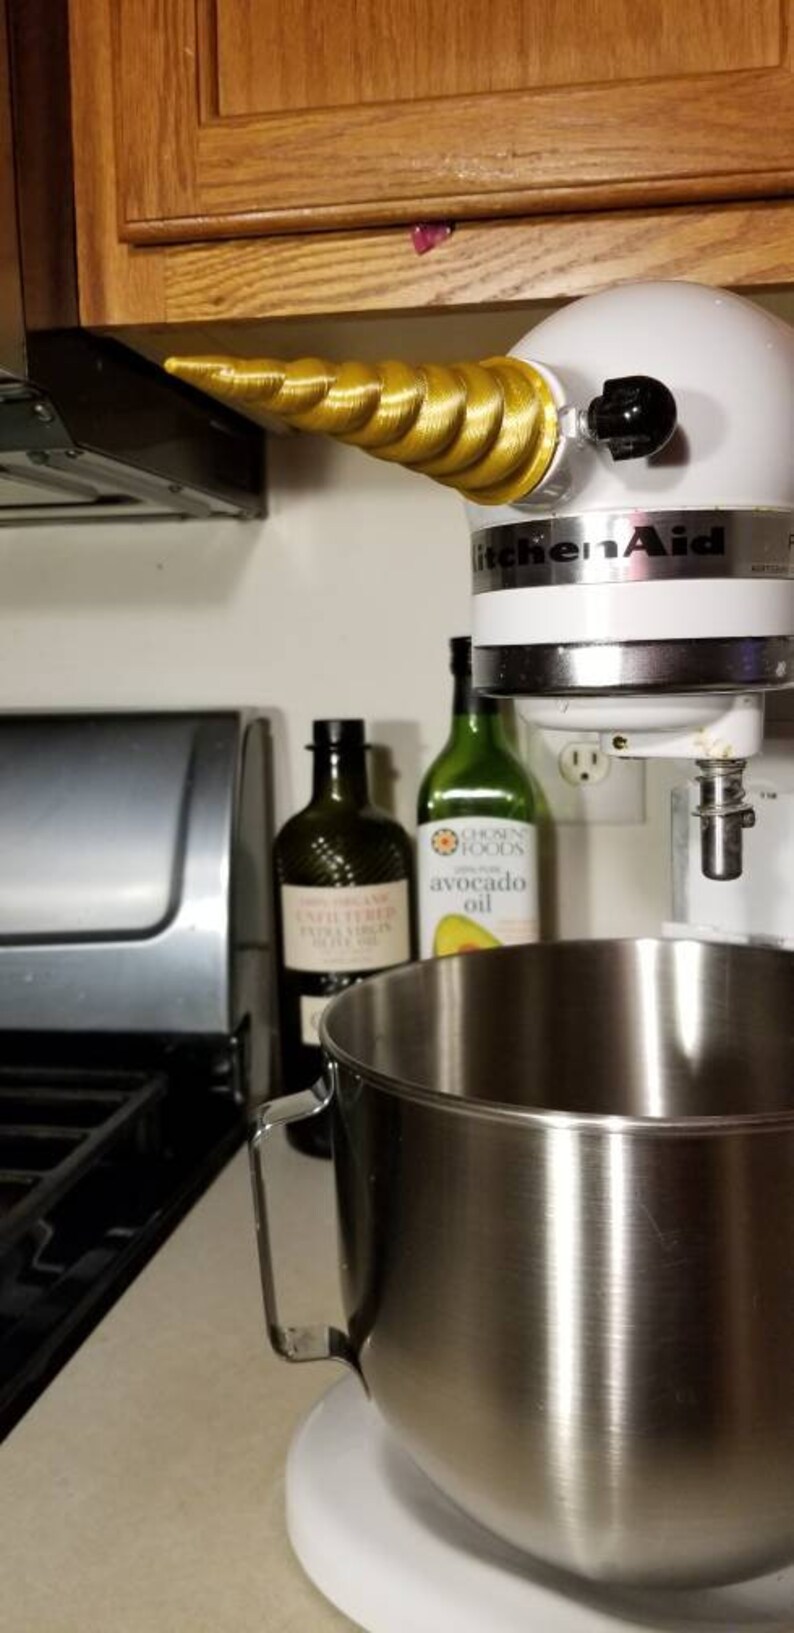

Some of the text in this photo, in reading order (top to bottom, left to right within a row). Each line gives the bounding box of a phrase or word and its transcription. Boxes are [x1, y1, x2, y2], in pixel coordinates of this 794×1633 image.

[473, 525, 726, 571] itchenAid
[461, 827, 524, 840] CHOSEN
[462, 842, 525, 857] FOODS
[430, 870, 527, 892] avocado
[463, 893, 493, 913] oil
